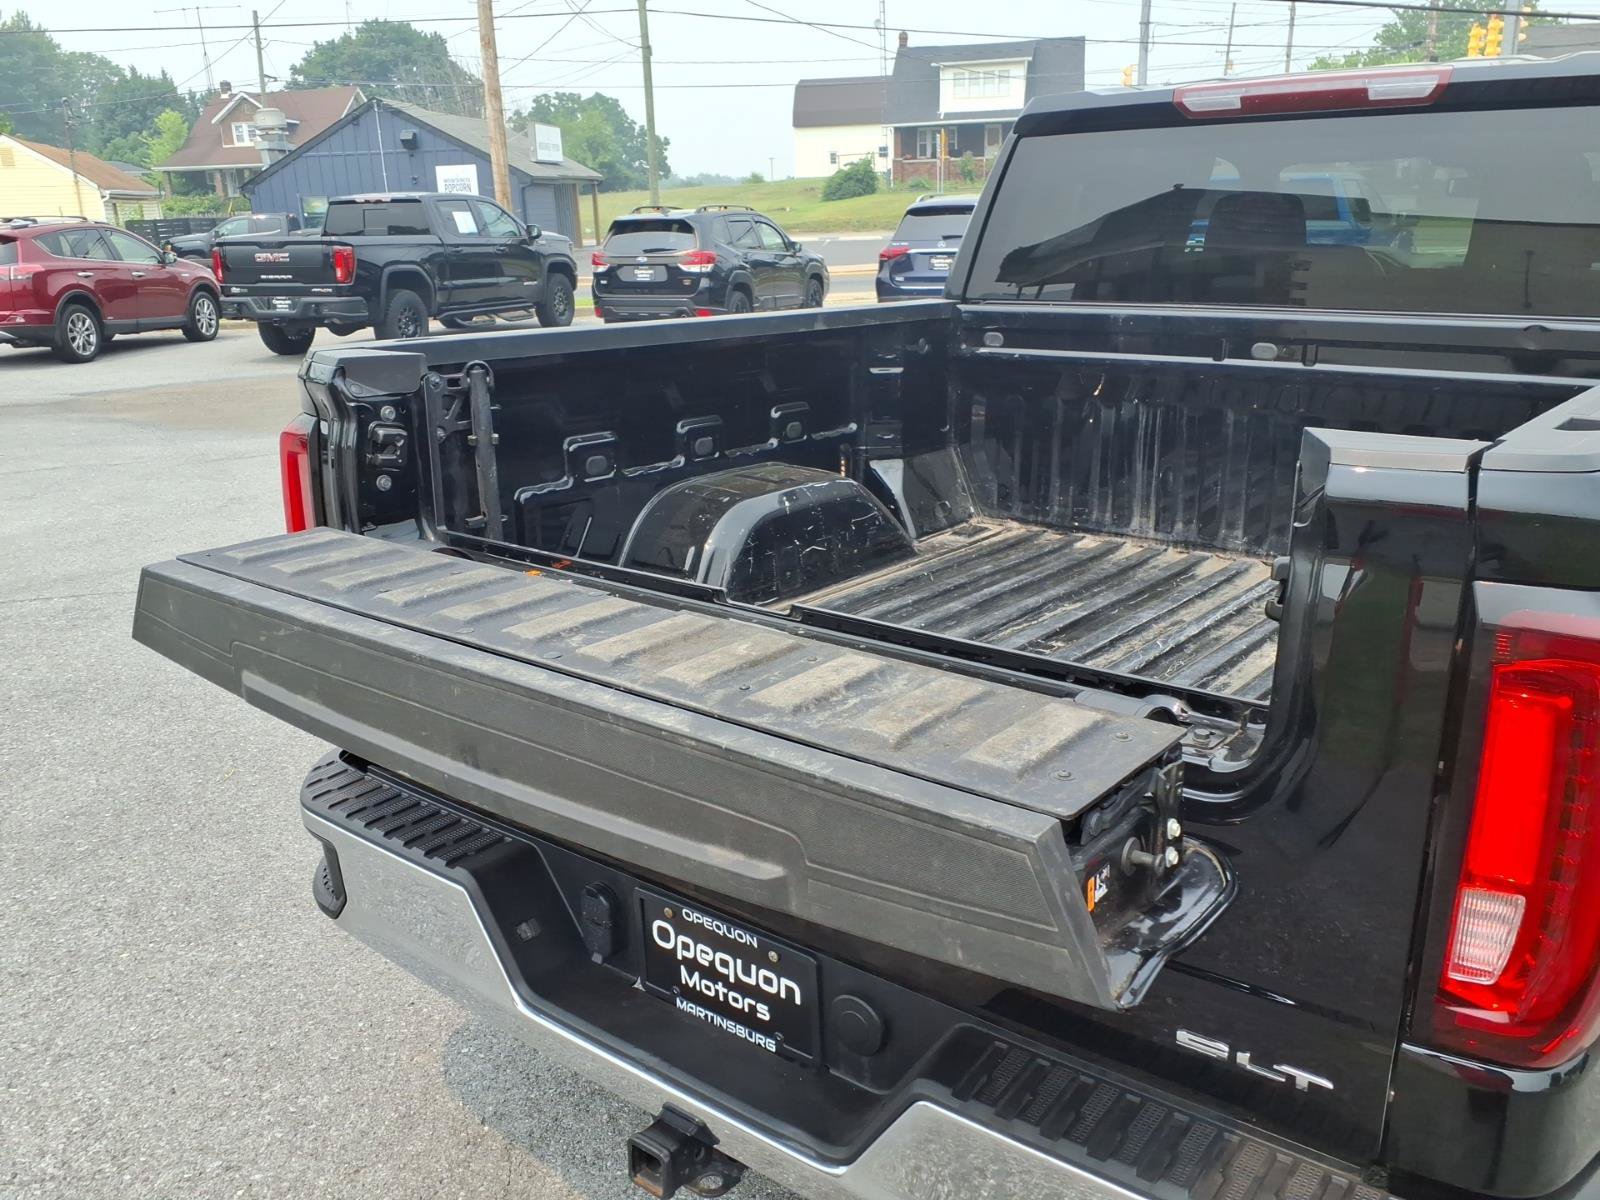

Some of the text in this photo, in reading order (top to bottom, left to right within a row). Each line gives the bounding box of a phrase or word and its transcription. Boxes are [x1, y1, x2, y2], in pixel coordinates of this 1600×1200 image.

[444, 183, 472, 193] POPCORN
[254, 252, 290, 263] GMC
[682, 908, 758, 948] OPEQUON
[652, 919, 802, 1006] Opequon
[680, 965, 771, 1021] Motors
[676, 998, 776, 1053] MARTINSBURG
[1176, 1028, 1334, 1092] SLT
